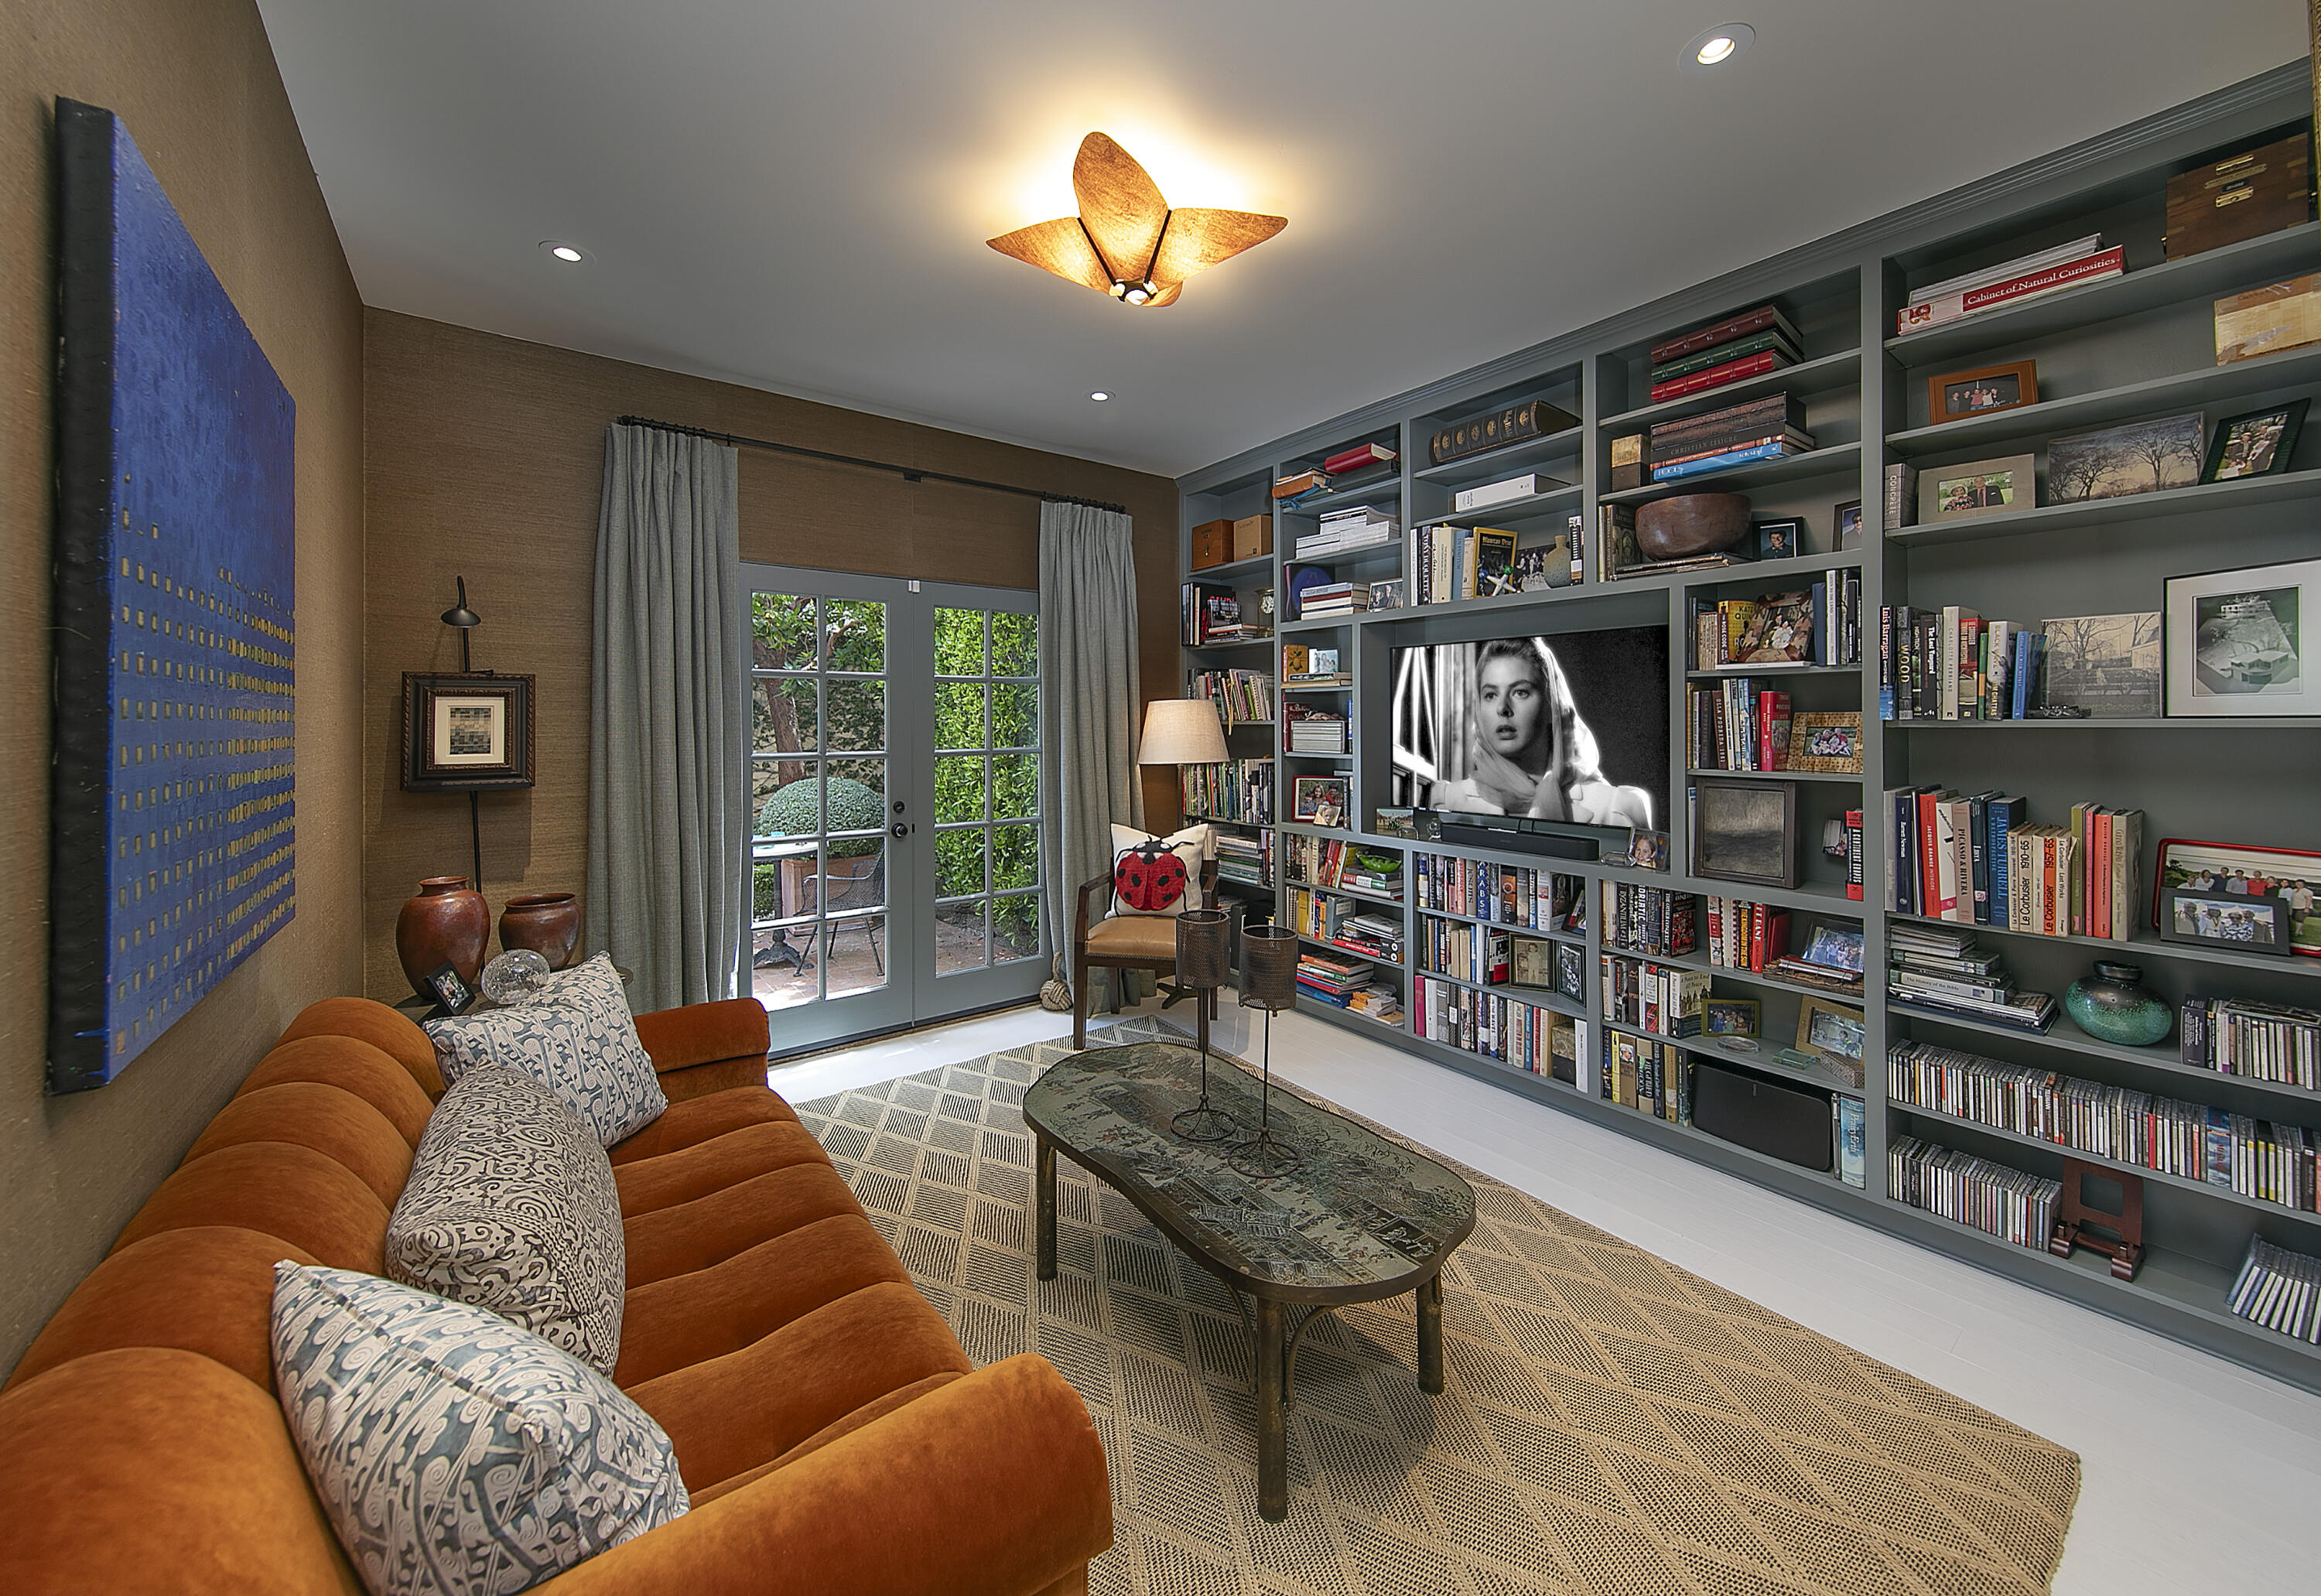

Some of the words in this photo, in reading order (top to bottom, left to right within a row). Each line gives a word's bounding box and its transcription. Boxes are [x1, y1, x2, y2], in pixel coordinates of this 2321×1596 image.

[1967, 289, 2004, 305] Cabinet
[2006, 283, 2017, 293] of
[2018, 273, 2056, 291] Natural
[2059, 258, 2115, 279] Curiosities
[1880, 624, 1890, 660] Barragan
[1900, 644, 1909, 682] WOOD
[1852, 833, 1862, 862] CONTINENT
[1957, 829, 1966, 860] PICASSO
[1996, 816, 2006, 849] JAMES
[2020, 840, 2030, 870] 1910-65
[2045, 839, 2054, 870] 1957-65
[1343, 875, 1356, 883] ROME
[1852, 863, 1861, 883] ERUPTS
[1960, 867, 1968, 895] RIVERA
[1997, 852, 2008, 900] TURRELL
[2020, 877, 2030, 915] Corbusier
[2045, 885, 2054, 921] Corbusier
[2020, 915, 2030, 926] Le
[2045, 922, 2053, 932] Le
